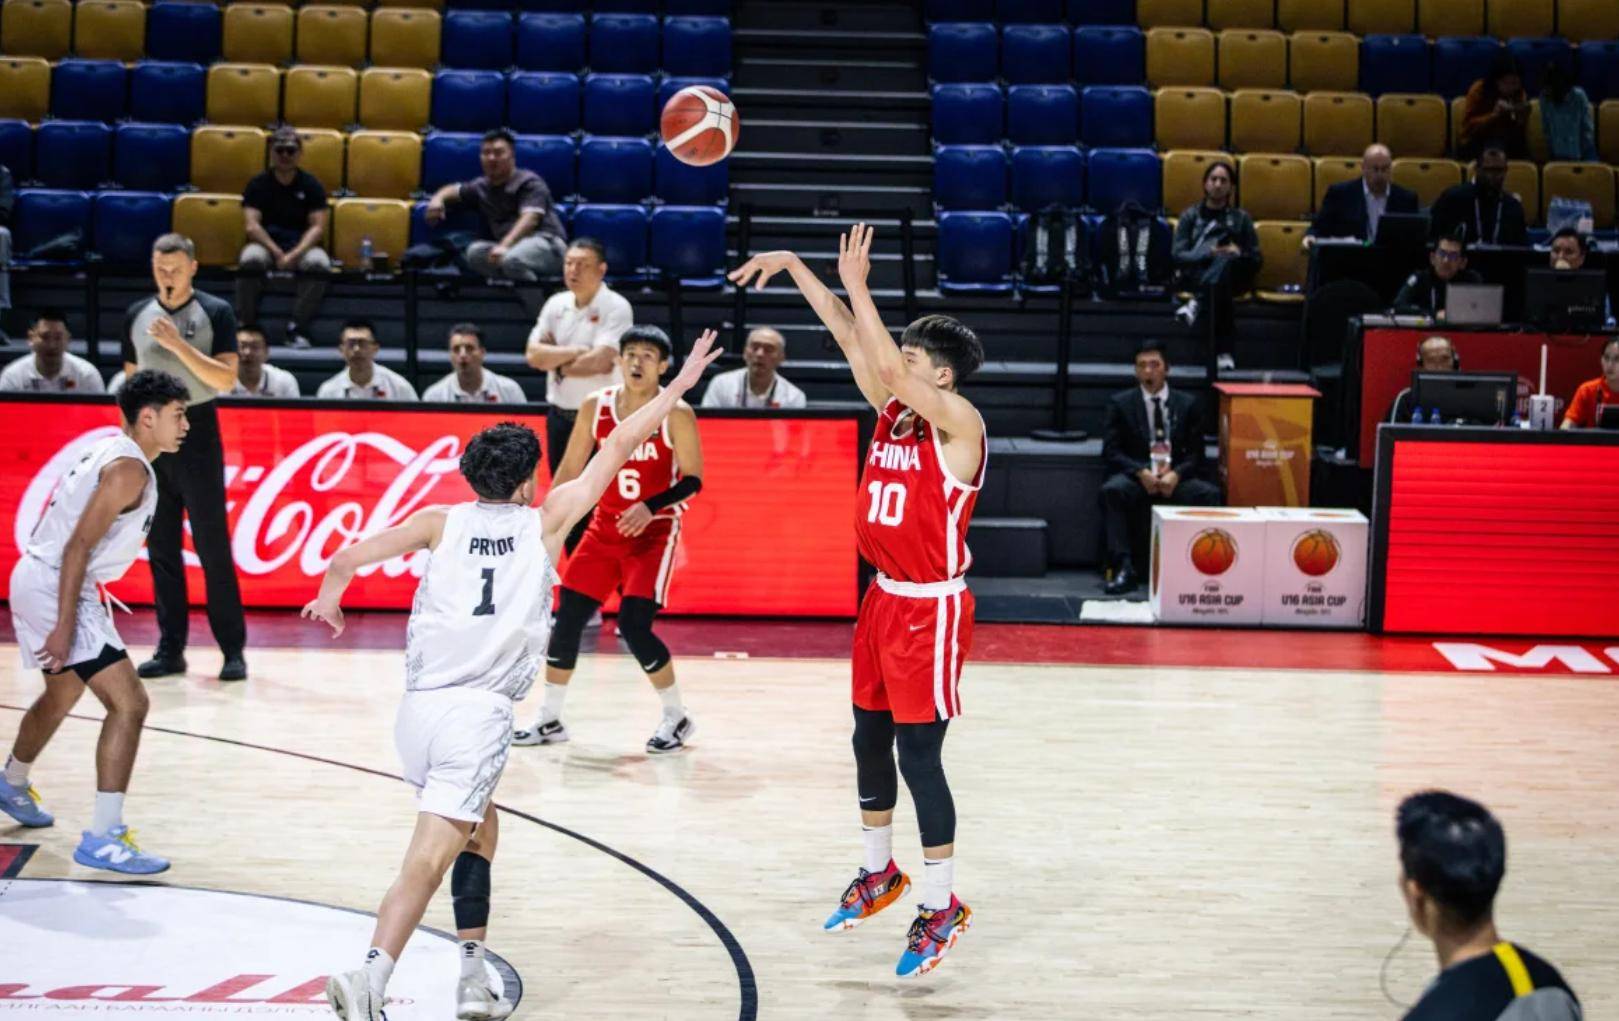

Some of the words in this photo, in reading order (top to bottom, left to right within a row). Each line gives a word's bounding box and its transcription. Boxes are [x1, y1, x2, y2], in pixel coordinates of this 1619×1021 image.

[869, 441, 921, 471] HINA
[618, 468, 641, 500] 6
[867, 480, 907, 527] 10
[472, 567, 496, 616] 1
[1199, 594, 1222, 606] ASIA
[1224, 594, 1244, 606] CUP
[1302, 595, 1325, 606] ASIA
[1327, 595, 1347, 607] CUP
